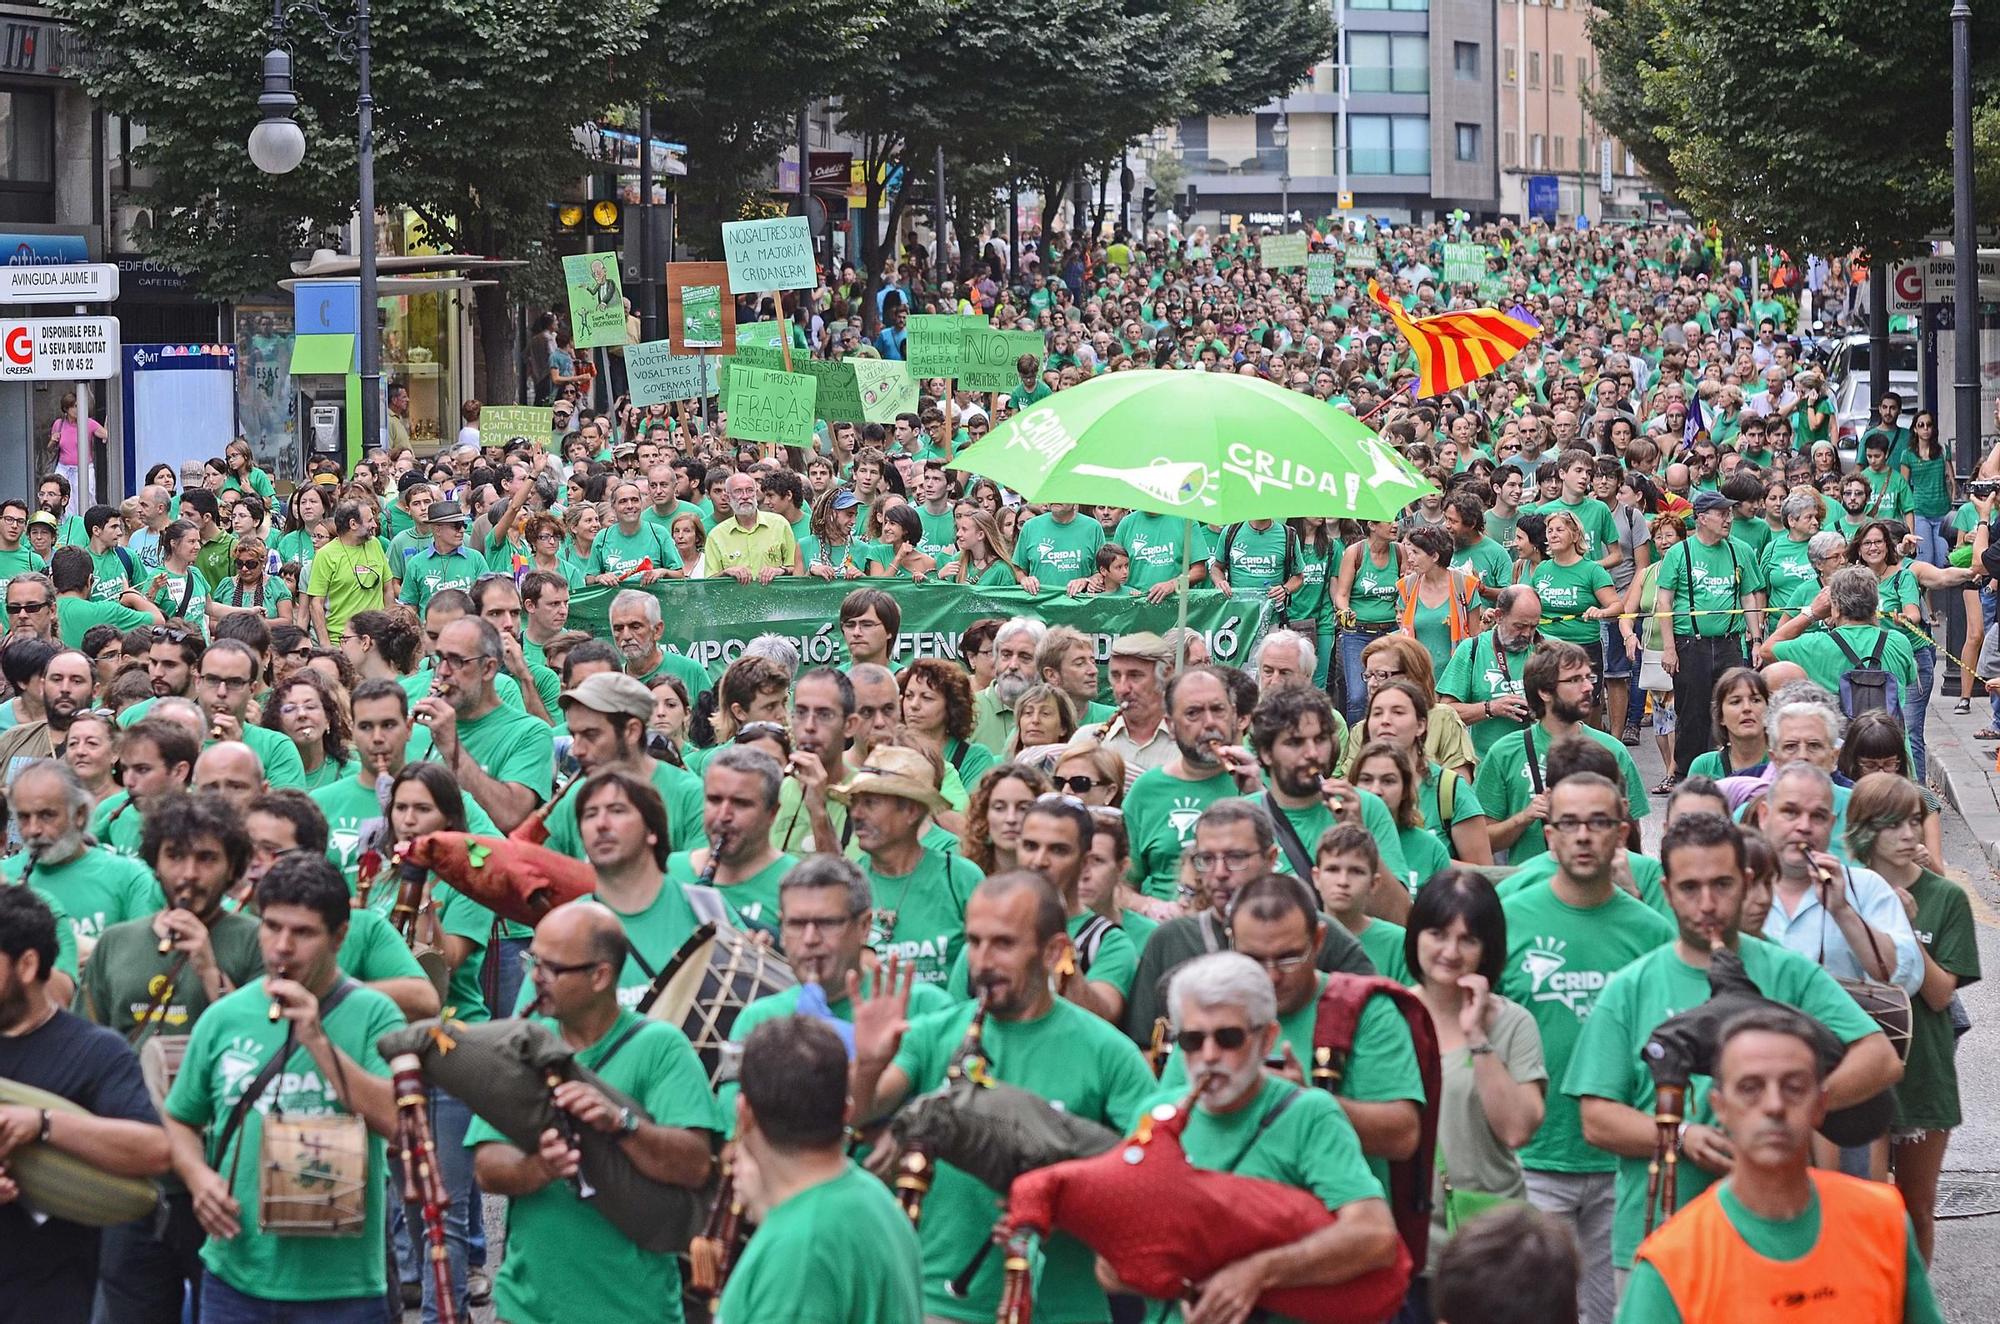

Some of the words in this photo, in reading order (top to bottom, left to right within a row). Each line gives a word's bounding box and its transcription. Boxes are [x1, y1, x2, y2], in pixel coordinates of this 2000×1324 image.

[729, 225, 787, 244] NOSALTRES
[789, 225, 810, 239] SOM
[735, 250, 750, 263] LA
[119, 260, 164, 272] EDIFICIO
[742, 265, 807, 281] CRIDANERA!
[12, 272, 57, 286] AVINGUDA
[59, 272, 88, 285] JAUME
[911, 317, 928, 330] JO
[42, 325, 81, 339] DISPONIBLE
[83, 325, 97, 337] PER
[98, 325, 103, 337] A
[39, 342, 47, 355] LA
[49, 342, 66, 355] SEVA
[68, 341, 106, 355] PUBLICITAT
[629, 346, 641, 357] SI
[964, 333, 1009, 367] NO
[6, 366, 33, 375] GREPSA
[53, 359, 64, 371] 971
[66, 359, 74, 370] 00
[76, 359, 84, 370] 45
[86, 358, 93, 370] 22
[634, 365, 691, 380] VOSALTRES
[733, 368, 759, 389] TIL
[763, 372, 806, 387] IMPOSAT
[963, 373, 1001, 387] QUATRE
[736, 389, 811, 424] FRACÀS
[482, 420, 514, 431] CONTRA
[518, 423, 528, 431] EL
[531, 423, 550, 432] TIL
[733, 416, 804, 436] ASSEGURAT
[1020, 407, 1078, 472] CRIDA!
[1228, 442, 1360, 511] CRIDA!
[1047, 549, 1081, 562] CRIDA!
[1141, 541, 1174, 556] CRIDA!
[1240, 555, 1276, 567] CRIDA!
[1704, 575, 1735, 588] CRIDA!
[1543, 586, 1578, 599] CRIDA!
[1501, 679, 1525, 691] CRI
